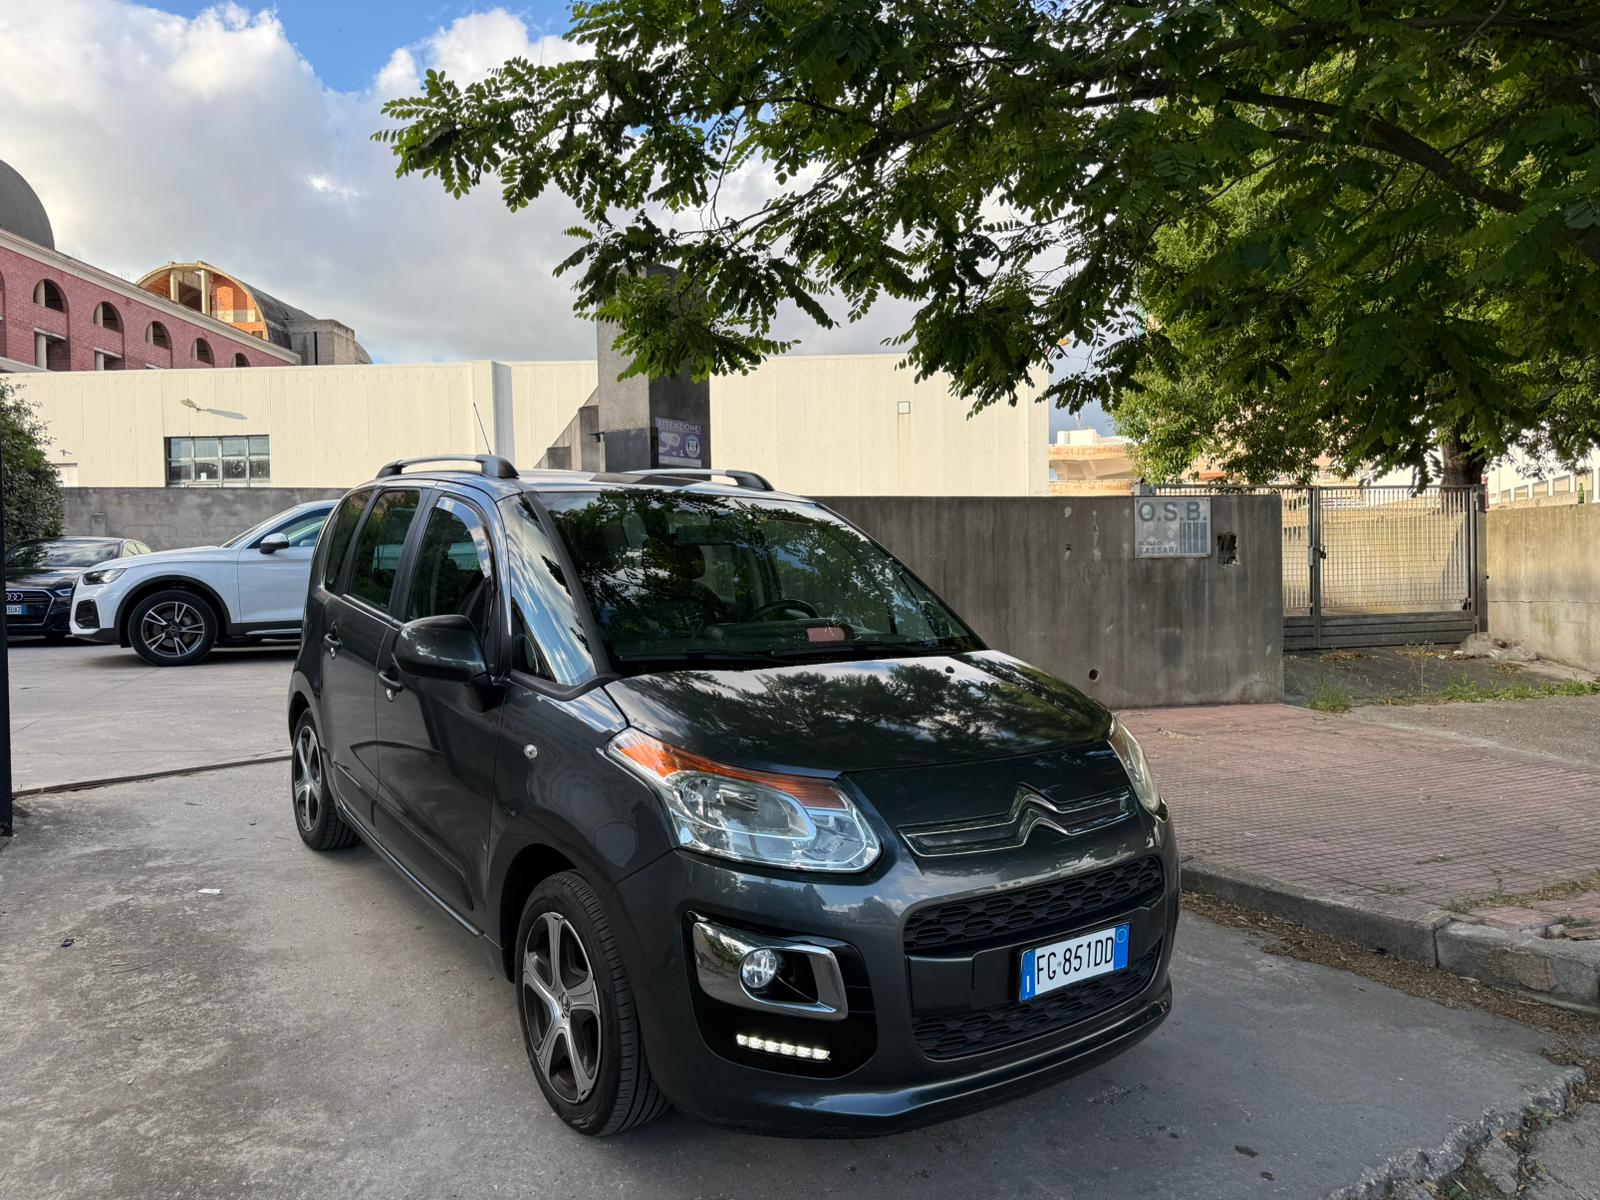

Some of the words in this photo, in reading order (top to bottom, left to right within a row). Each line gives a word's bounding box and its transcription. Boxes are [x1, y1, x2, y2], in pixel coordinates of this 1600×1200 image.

[1138, 501, 1207, 522] O.S.B.
[1138, 546, 1178, 555] SASSARI
[1063, 936, 1114, 975] 851DD
